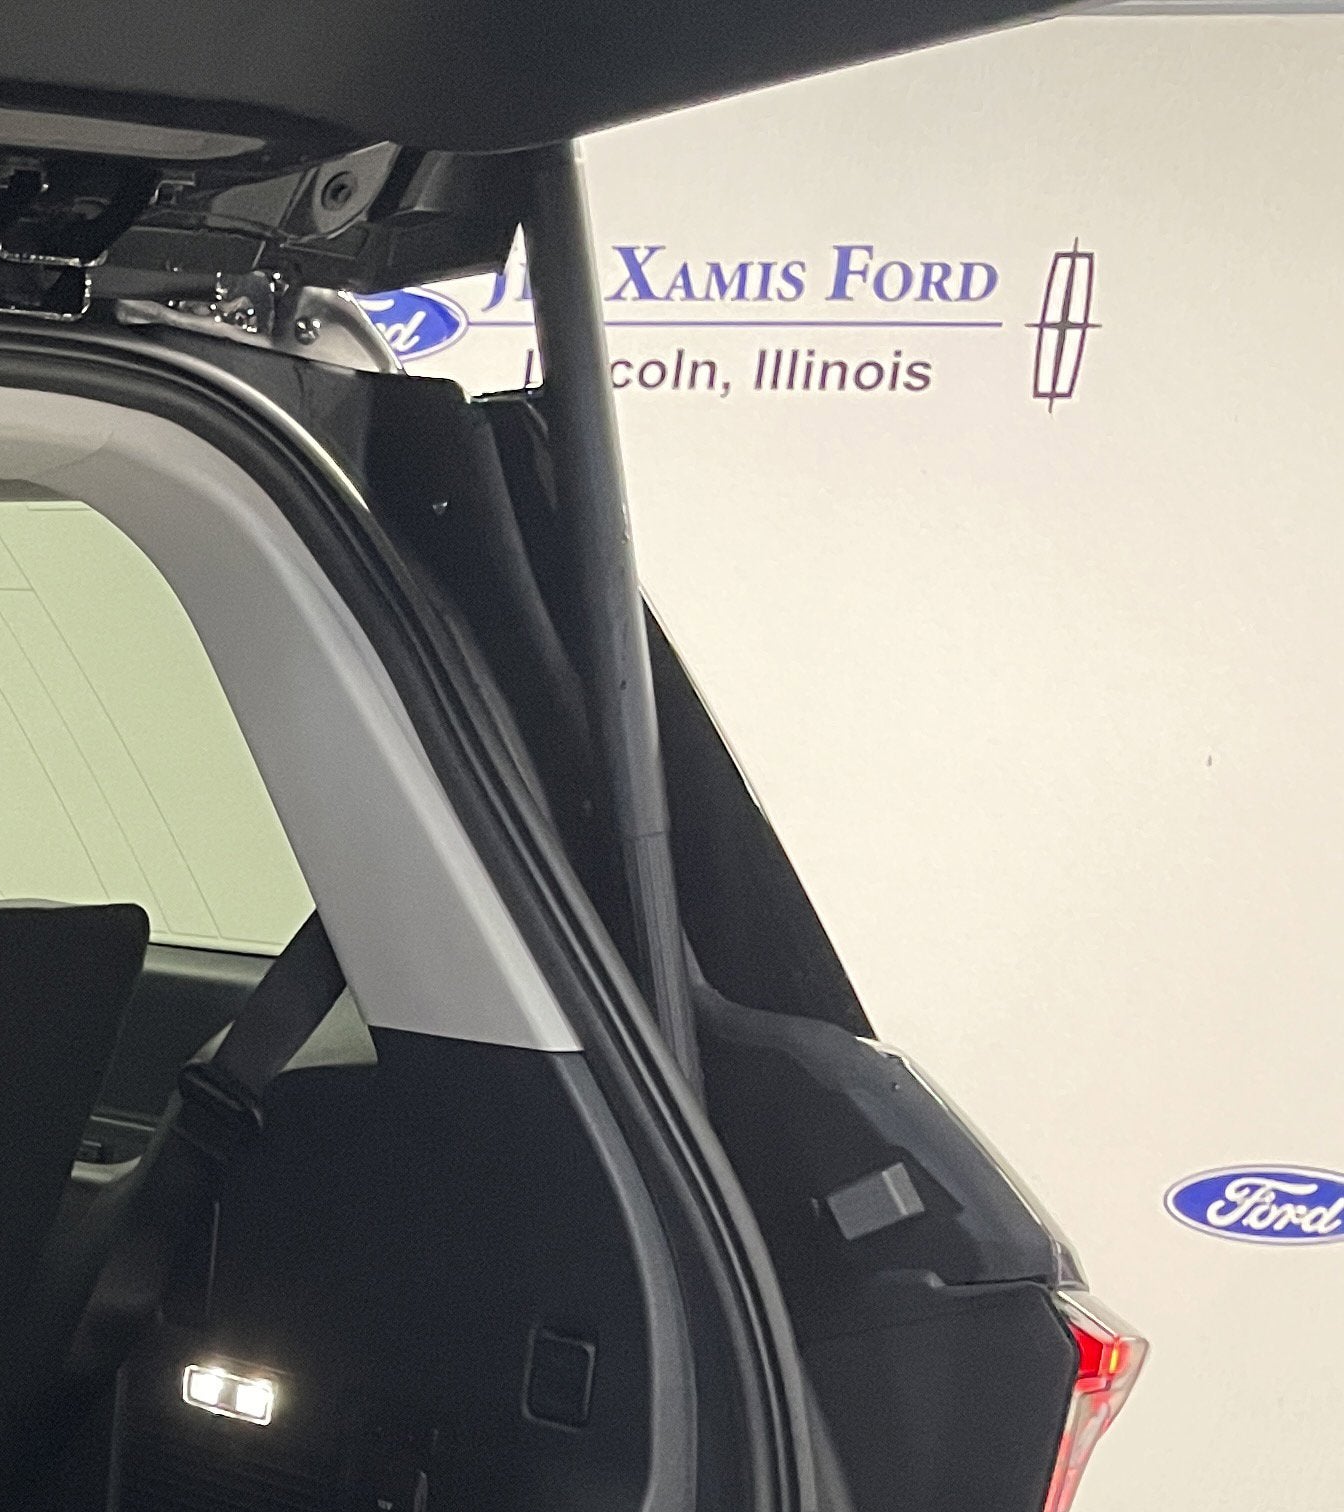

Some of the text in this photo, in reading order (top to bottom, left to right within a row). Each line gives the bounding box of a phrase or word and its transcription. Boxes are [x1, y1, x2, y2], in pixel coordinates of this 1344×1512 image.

[604, 244, 808, 303] XAMIS
[825, 244, 1000, 303] FORD
[753, 348, 933, 392] Illinois
[1206, 1176, 1344, 1234] Ford
